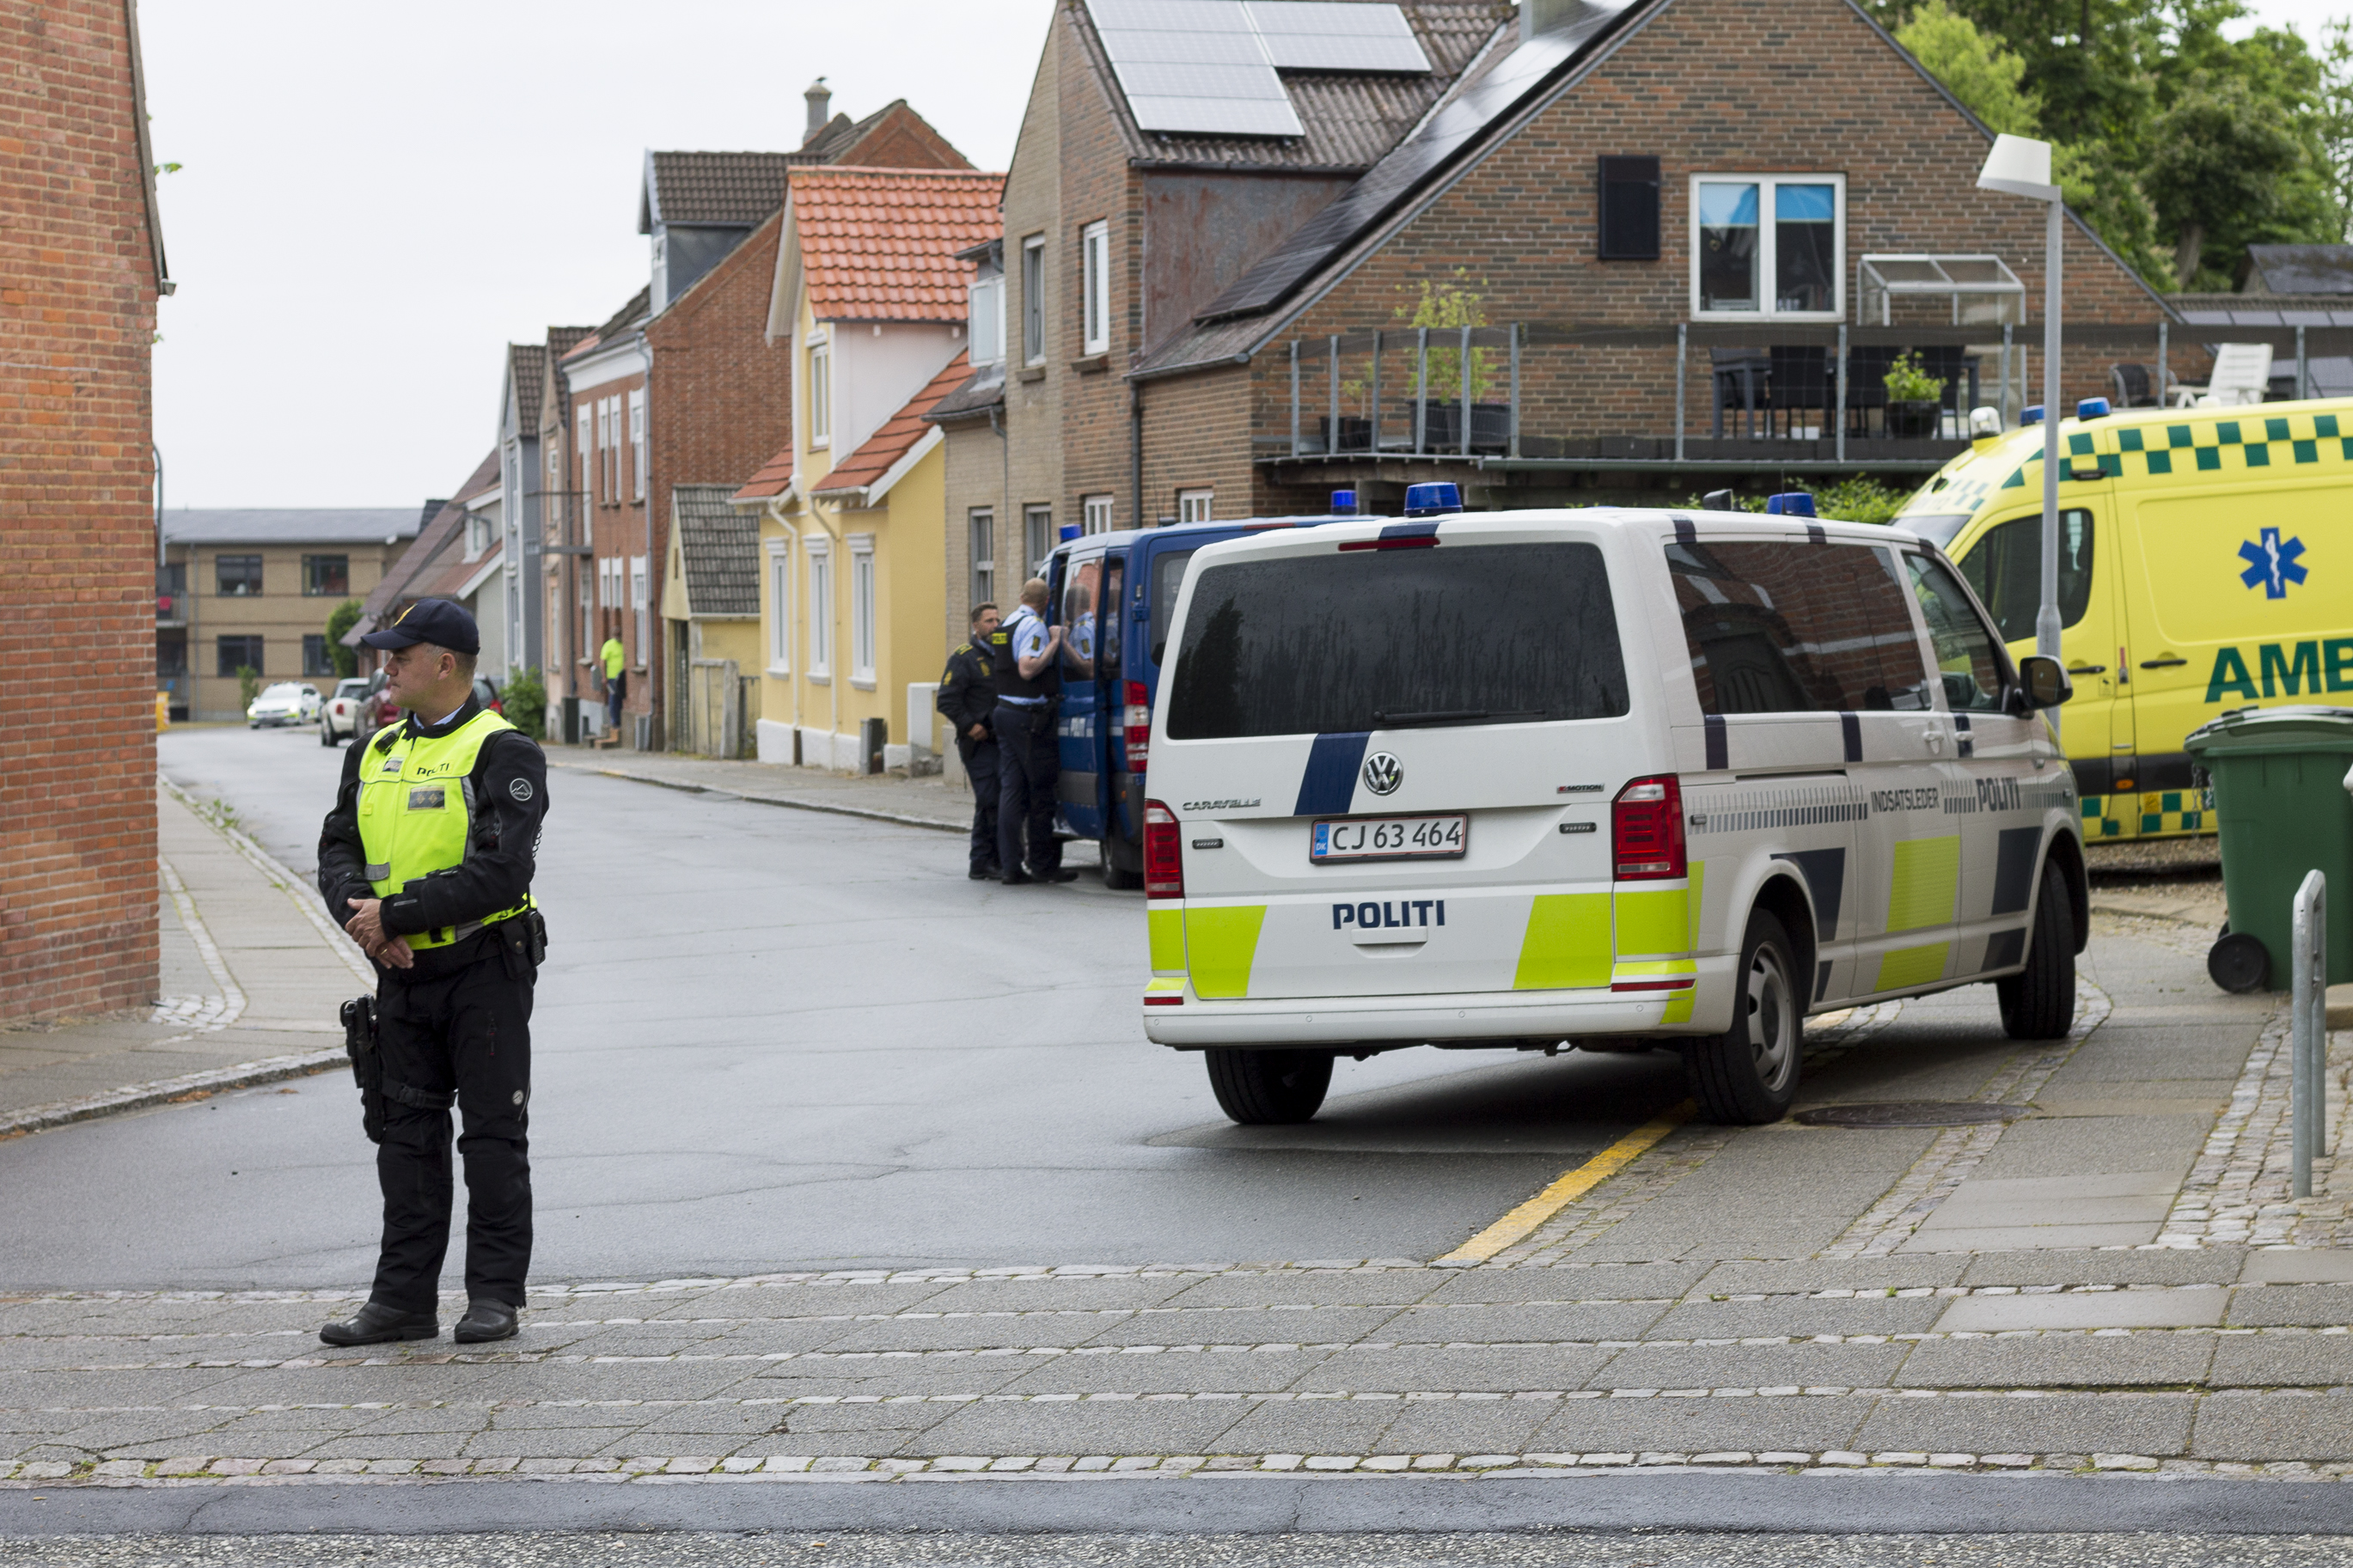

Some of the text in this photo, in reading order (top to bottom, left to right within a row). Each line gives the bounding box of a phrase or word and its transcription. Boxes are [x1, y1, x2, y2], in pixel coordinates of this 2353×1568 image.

[2204, 638, 2353, 704] AMB
[417, 763, 449, 777] PTI
[1183, 798, 1262, 811] CARAVELLE
[1870, 787, 1940, 813] INDSATSLEDER
[1976, 777, 2020, 813] POLITI
[1316, 842, 1327, 851] DK
[1333, 821, 1461, 851] CJ 63 464
[1332, 900, 1445, 930] POLITI
